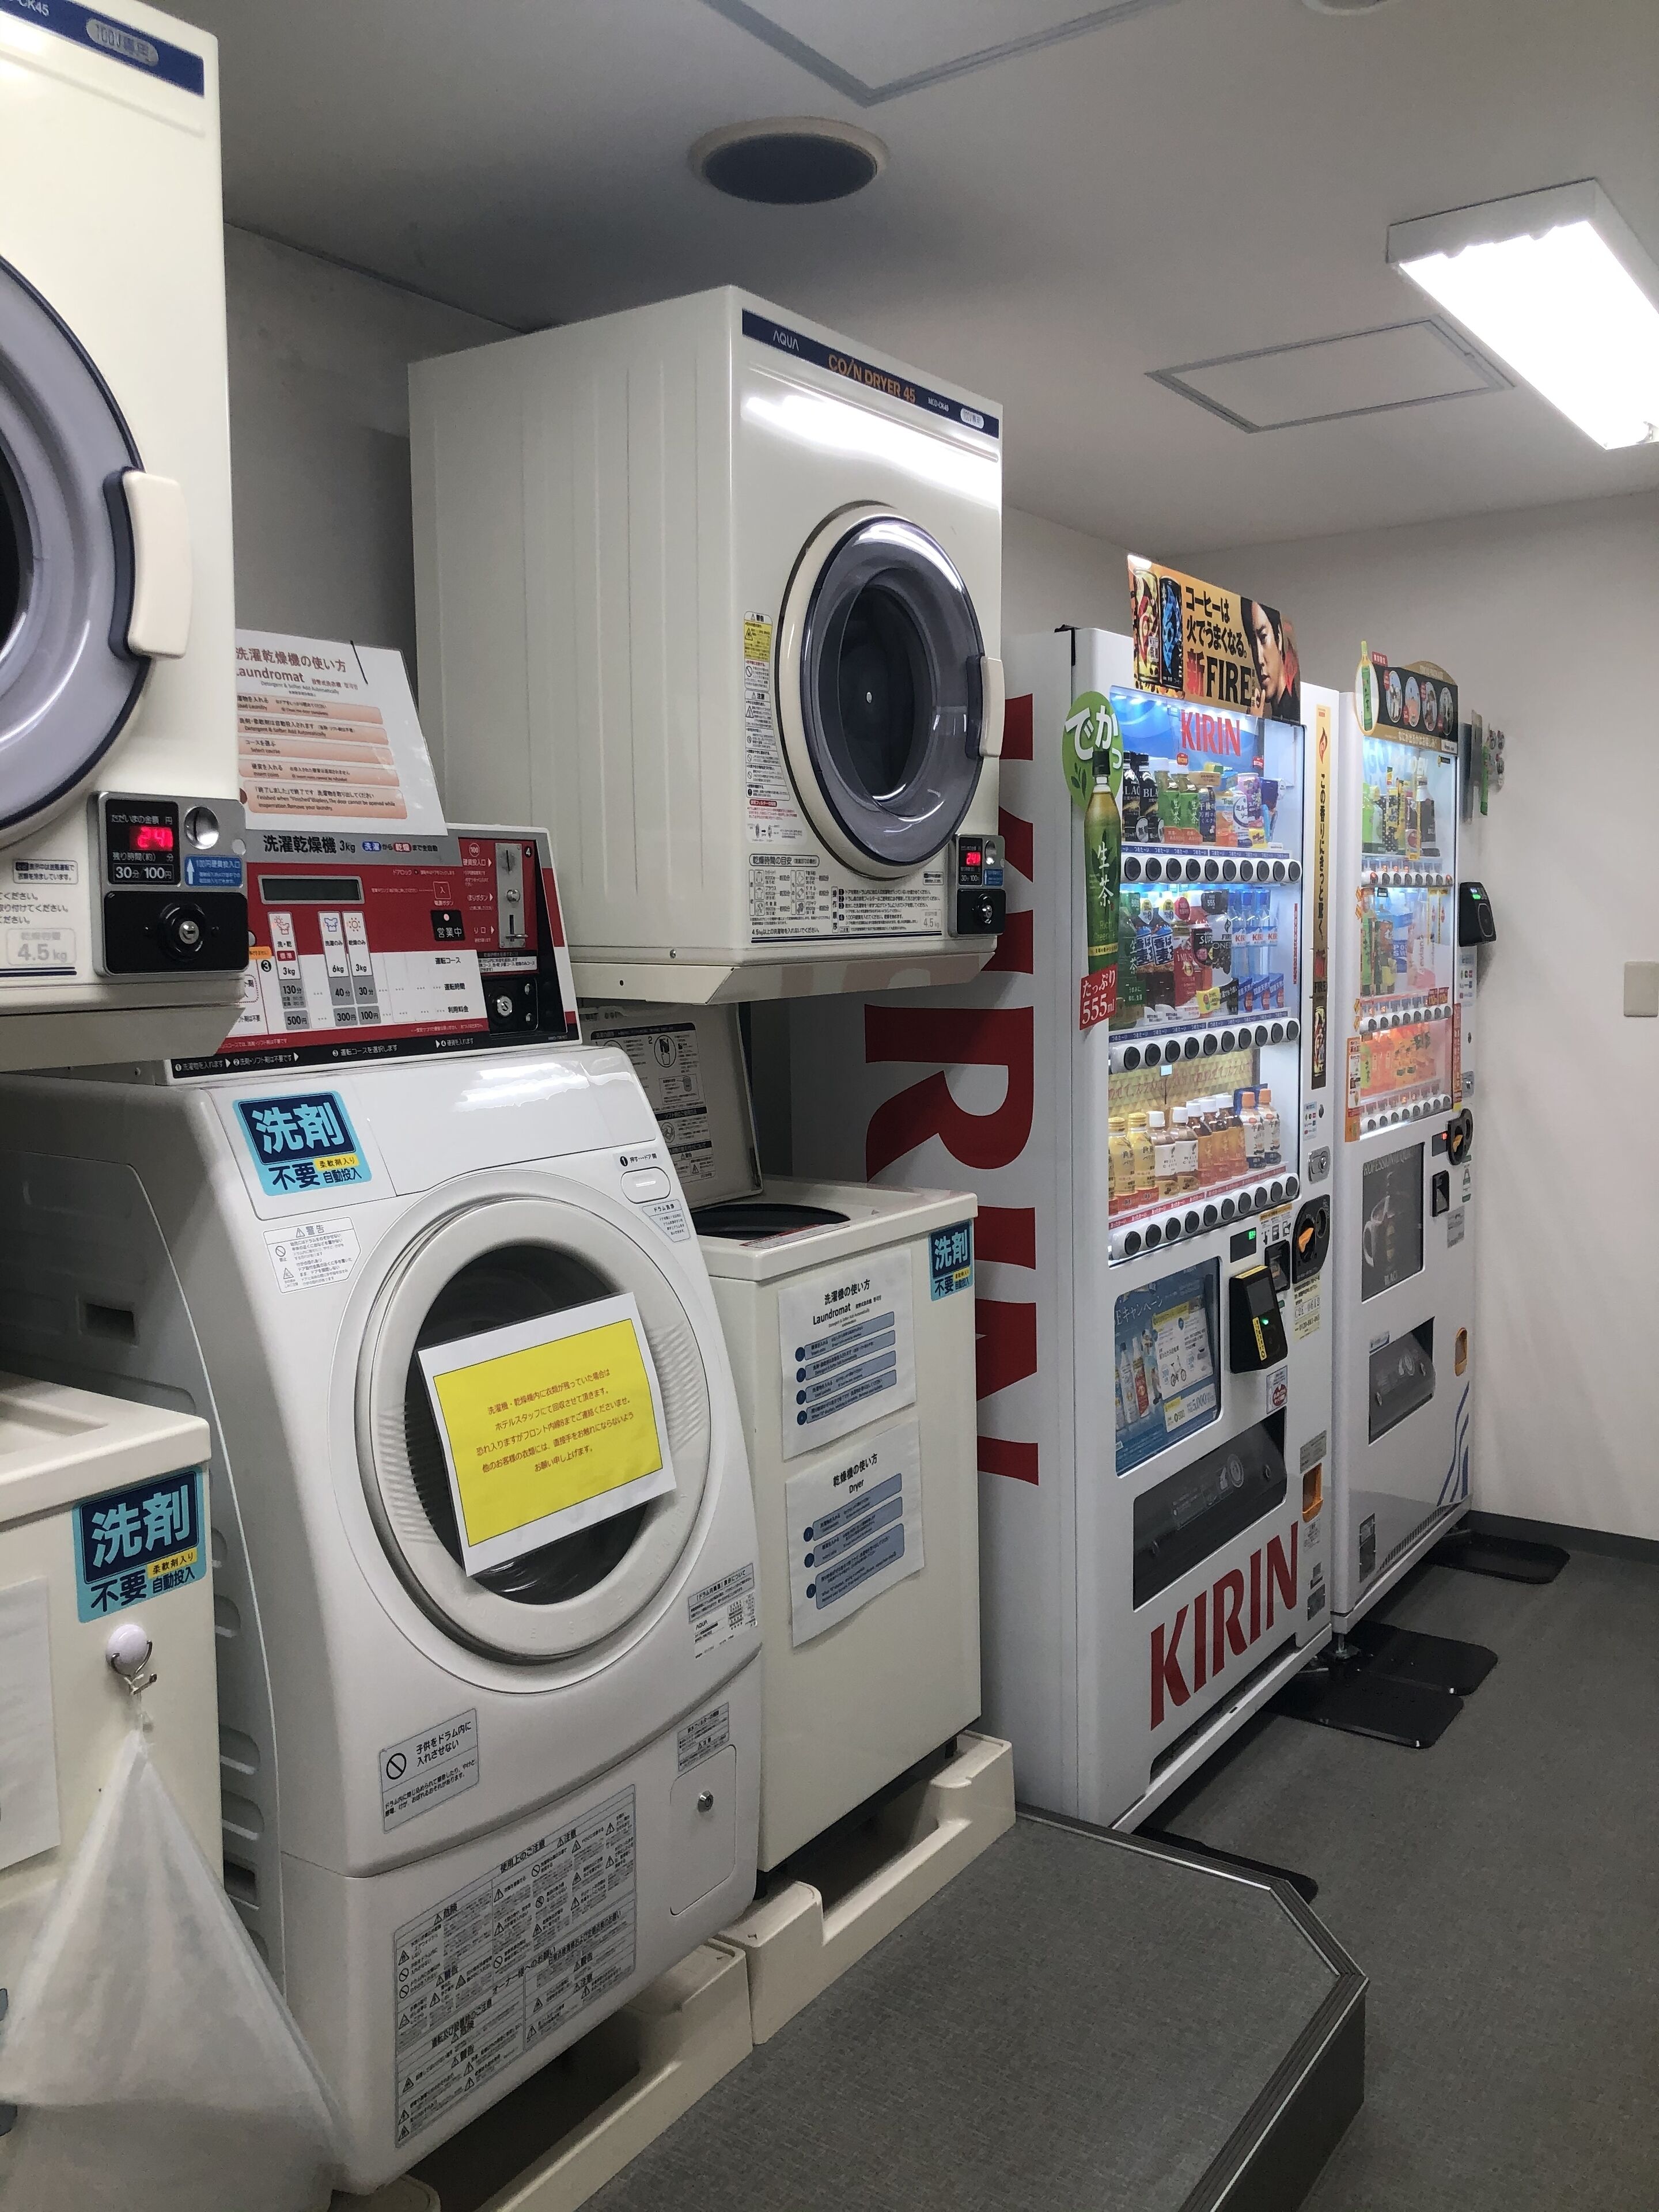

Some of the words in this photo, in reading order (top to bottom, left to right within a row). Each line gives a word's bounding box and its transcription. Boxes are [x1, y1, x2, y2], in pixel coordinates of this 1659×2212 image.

[774, 330, 800, 351] AQUA
[864, 369, 901, 397] DRYER
[903, 387, 916, 404] 45
[1185, 586, 1230, 624] コーヒーは
[1187, 616, 1247, 659] 火でうまくなる。
[236, 647, 346, 673] 洗濯乾燥機の使い方
[237, 667, 305, 683] aundromat
[1206, 656, 1252, 707] FIRE
[1180, 709, 1241, 757] KIRIN
[111, 815, 160, 825] ただいまの金額
[165, 816, 173, 825] 円
[112, 852, 156, 862] 残り時間(約)
[166, 854, 173, 862] 分
[263, 835, 337, 854] 洗濯乾燥機
[339, 840, 355, 853] 3kg
[463, 858, 486, 866] 硬貨投入口
[752, 856, 792, 865] 乾燥時間の目安
[1097, 840, 1115, 907] 生茶
[436, 926, 463, 938] 営業中
[17, 943, 50, 961] 4.5
[53, 949, 68, 962] kg
[435, 956, 461, 965] 運転コース
[283, 967, 296, 976] 3kg
[332, 964, 344, 974] 6kg
[355, 963, 367, 973] 3kg
[1082, 969, 1116, 998] たっぷり
[282, 985, 302, 995] 130分
[335, 988, 351, 997] 40分
[359, 986, 374, 996] 30分
[444, 982, 466, 991] 運転時間
[287, 1016, 308, 1025] 500円
[337, 1012, 357, 1022] 300円
[361, 1010, 379, 1020] 100円
[448, 1005, 469, 1014] 利用料金
[1082, 993, 1115, 1025] 555ml
[340, 1044, 398, 1056] 運転コースを選択します
[251, 1102, 345, 1154] 洗剤
[268, 1161, 321, 1191] 不要
[319, 1156, 356, 1169] 柔軟剤入り
[323, 1167, 362, 1184] 自動投入
[305, 1225, 325, 1234] 警告
[934, 1228, 968, 1271] 洗剤
[824, 1278, 871, 1306] 洗濯機の使い方
[934, 1274, 955, 1298] 不要
[812, 1302, 851, 1326] Laundromat
[487, 1369, 611, 1416] 洗濯機・乾燥機内に衣類が残っていた場合は
[495, 1387, 609, 1431] ホテルスタッフにて回収させて頂きます。
[476, 1396, 632, 1457] 恐れ入りますがフロント内線8までご連絡くださいませ。
[482, 1411, 635, 1474] 他のお客様の衣類には、直接手をお触れにならないよう
[534, 1446, 594, 1473] お願い申し上げます。
[832, 1452, 878, 1488] 乾燥機の使い方
[849, 1479, 865, 1494] Dryer
[90, 1484, 191, 1569] 洗剤
[90, 1568, 147, 1613] 不要
[152, 1551, 195, 1575] 柔軟剤入り
[152, 1565, 196, 1595] 自動投入
[1150, 1520, 1299, 1732] KIRIN
[415, 1721, 472, 1755] 子供をドラム内に
[416, 1739, 460, 1767] 入れさせない
[500, 1838, 546, 1874] 使用上のご注意
